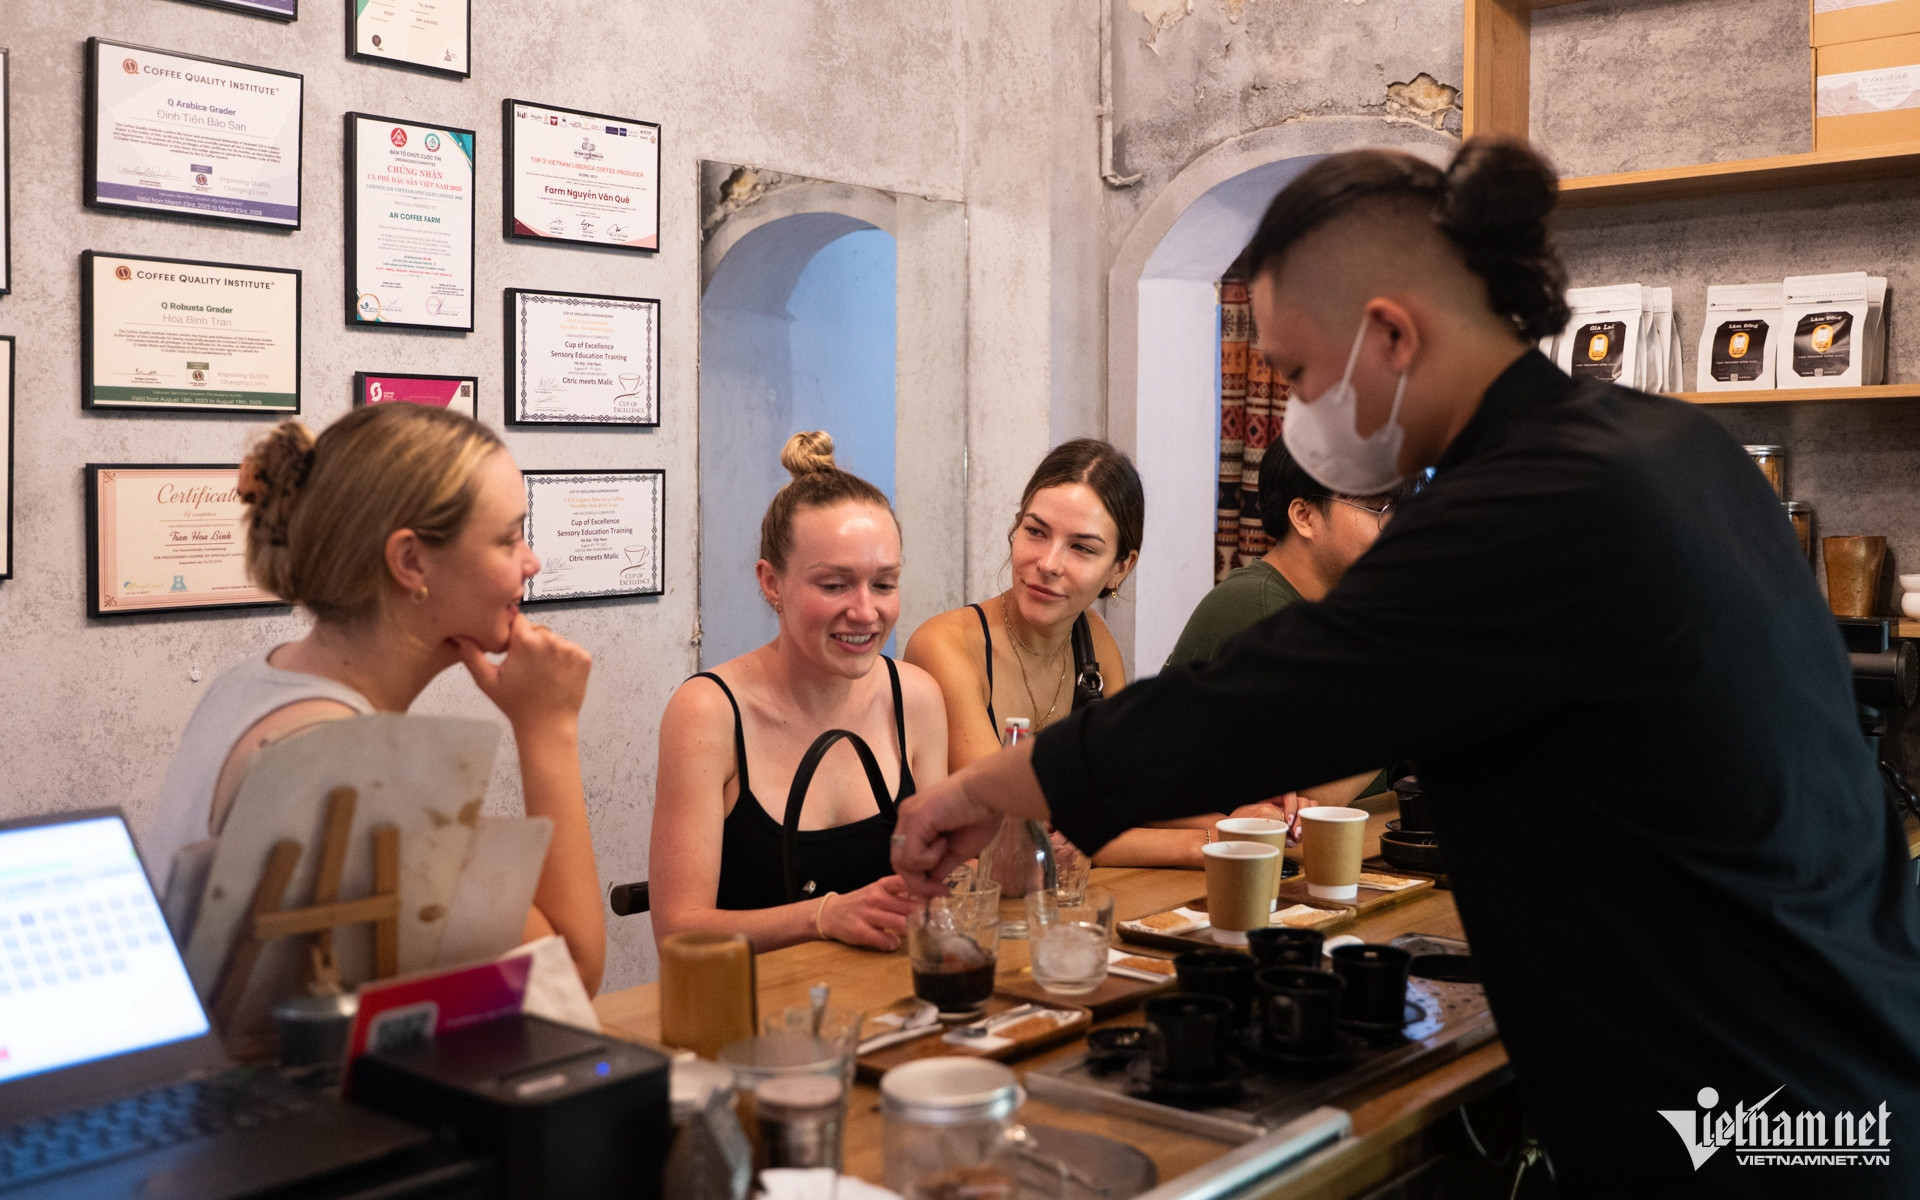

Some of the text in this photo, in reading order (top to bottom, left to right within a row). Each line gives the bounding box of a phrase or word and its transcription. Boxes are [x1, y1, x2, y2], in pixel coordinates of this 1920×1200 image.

[143, 66, 182, 79] COFFEE
[185, 73, 226, 87] QUALITY
[167, 98, 236, 116] Q Arabica Grader
[228, 120, 246, 132] San
[547, 159, 571, 168] VIETNAM
[572, 162, 595, 171] LIBERICA
[596, 166, 616, 175] COFFEE
[617, 169, 644, 178] PRODUCER
[545, 185, 566, 196] Farm
[219, 204, 236, 213] March
[400, 213, 423, 222] COFFEE
[136, 270, 176, 282] COFFEE
[179, 274, 221, 285] QUALITY
[161, 302, 233, 314] Q Robusta Grader
[162, 313, 183, 323] Hoa
[210, 316, 232, 327] Tran
[565, 341, 577, 349] Cup
[584, 342, 614, 350] Excellence
[551, 350, 574, 359] Sensory
[604, 354, 627, 362] Training
[217, 371, 269, 381] Improving Quality
[221, 379, 247, 388] Changing
[192, 531, 208, 541] Hoa
